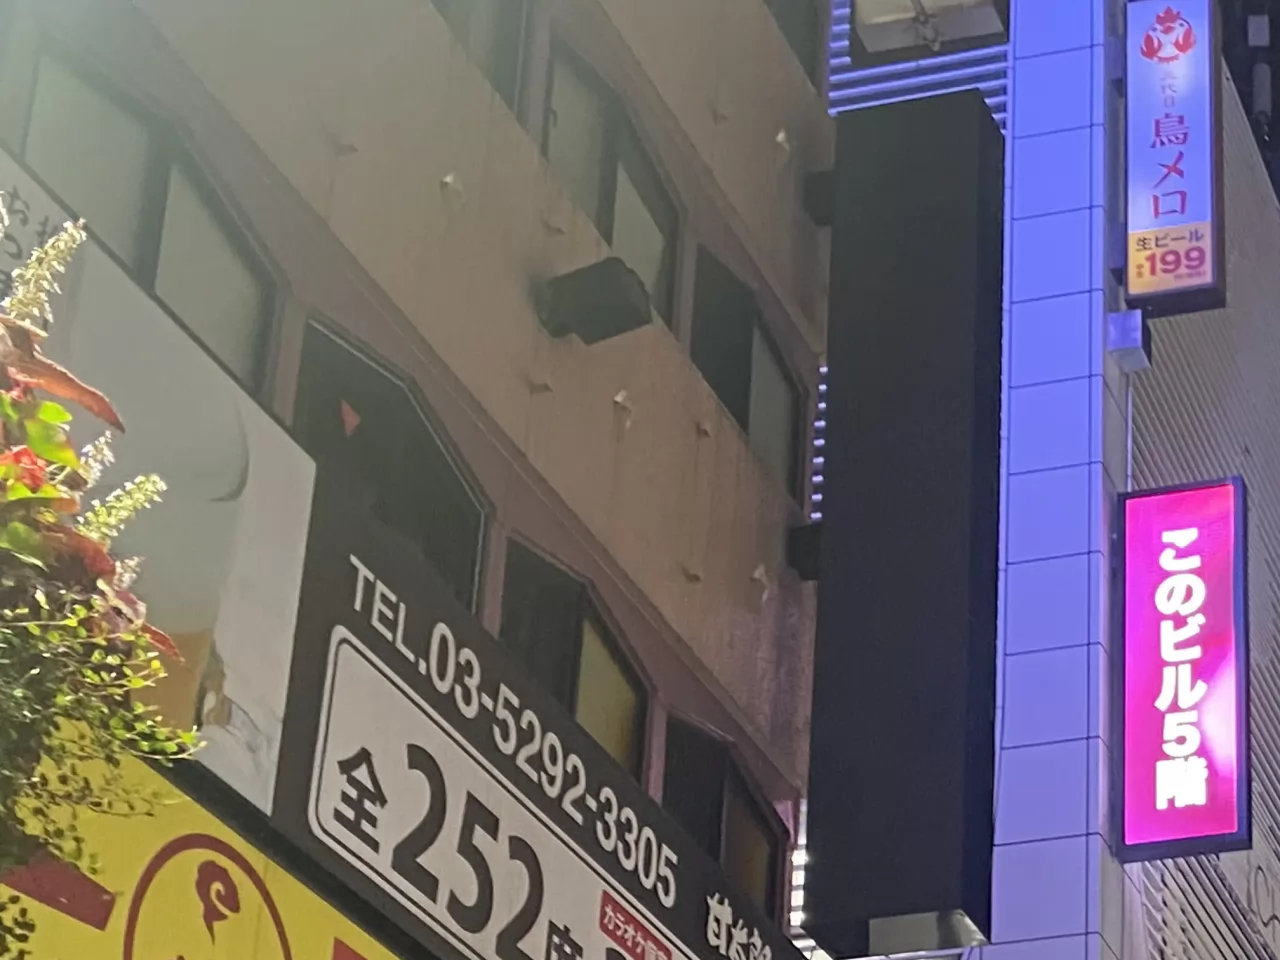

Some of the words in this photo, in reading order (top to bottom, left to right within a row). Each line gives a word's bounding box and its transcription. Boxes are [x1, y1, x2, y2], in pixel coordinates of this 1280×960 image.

[1136, 228, 1204, 252] 生ビール
[1150, 113, 1191, 219] 鳥メロ
[350, 554, 678, 908] TEL.03-5292-3305
[1154, 527, 1208, 810] このビル5階
